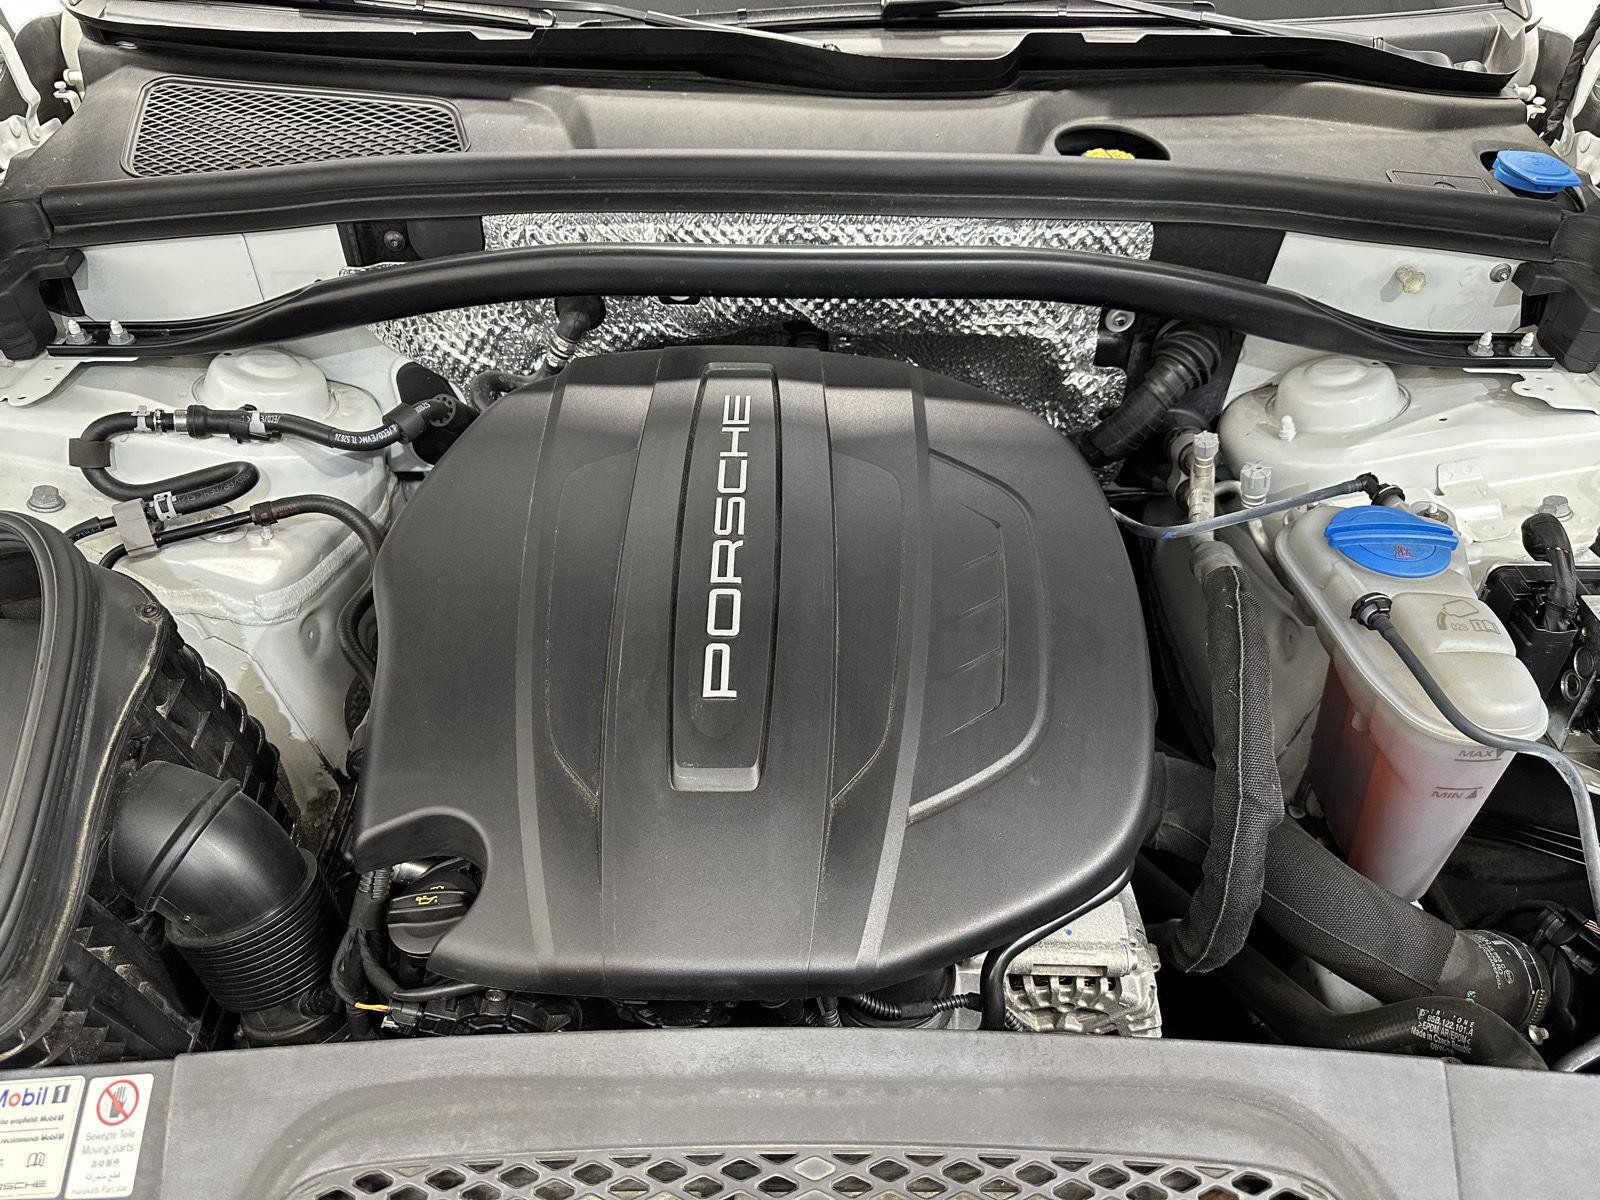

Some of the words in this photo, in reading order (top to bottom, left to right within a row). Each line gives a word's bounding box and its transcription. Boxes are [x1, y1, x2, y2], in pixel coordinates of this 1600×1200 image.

[702, 395, 751, 699] PORSCHE
[1431, 791, 1463, 799] MIN
[1411, 1025, 1426, 1039] Made
[55, 1085, 69, 1104] 1
[112, 1143, 135, 1154] parts
